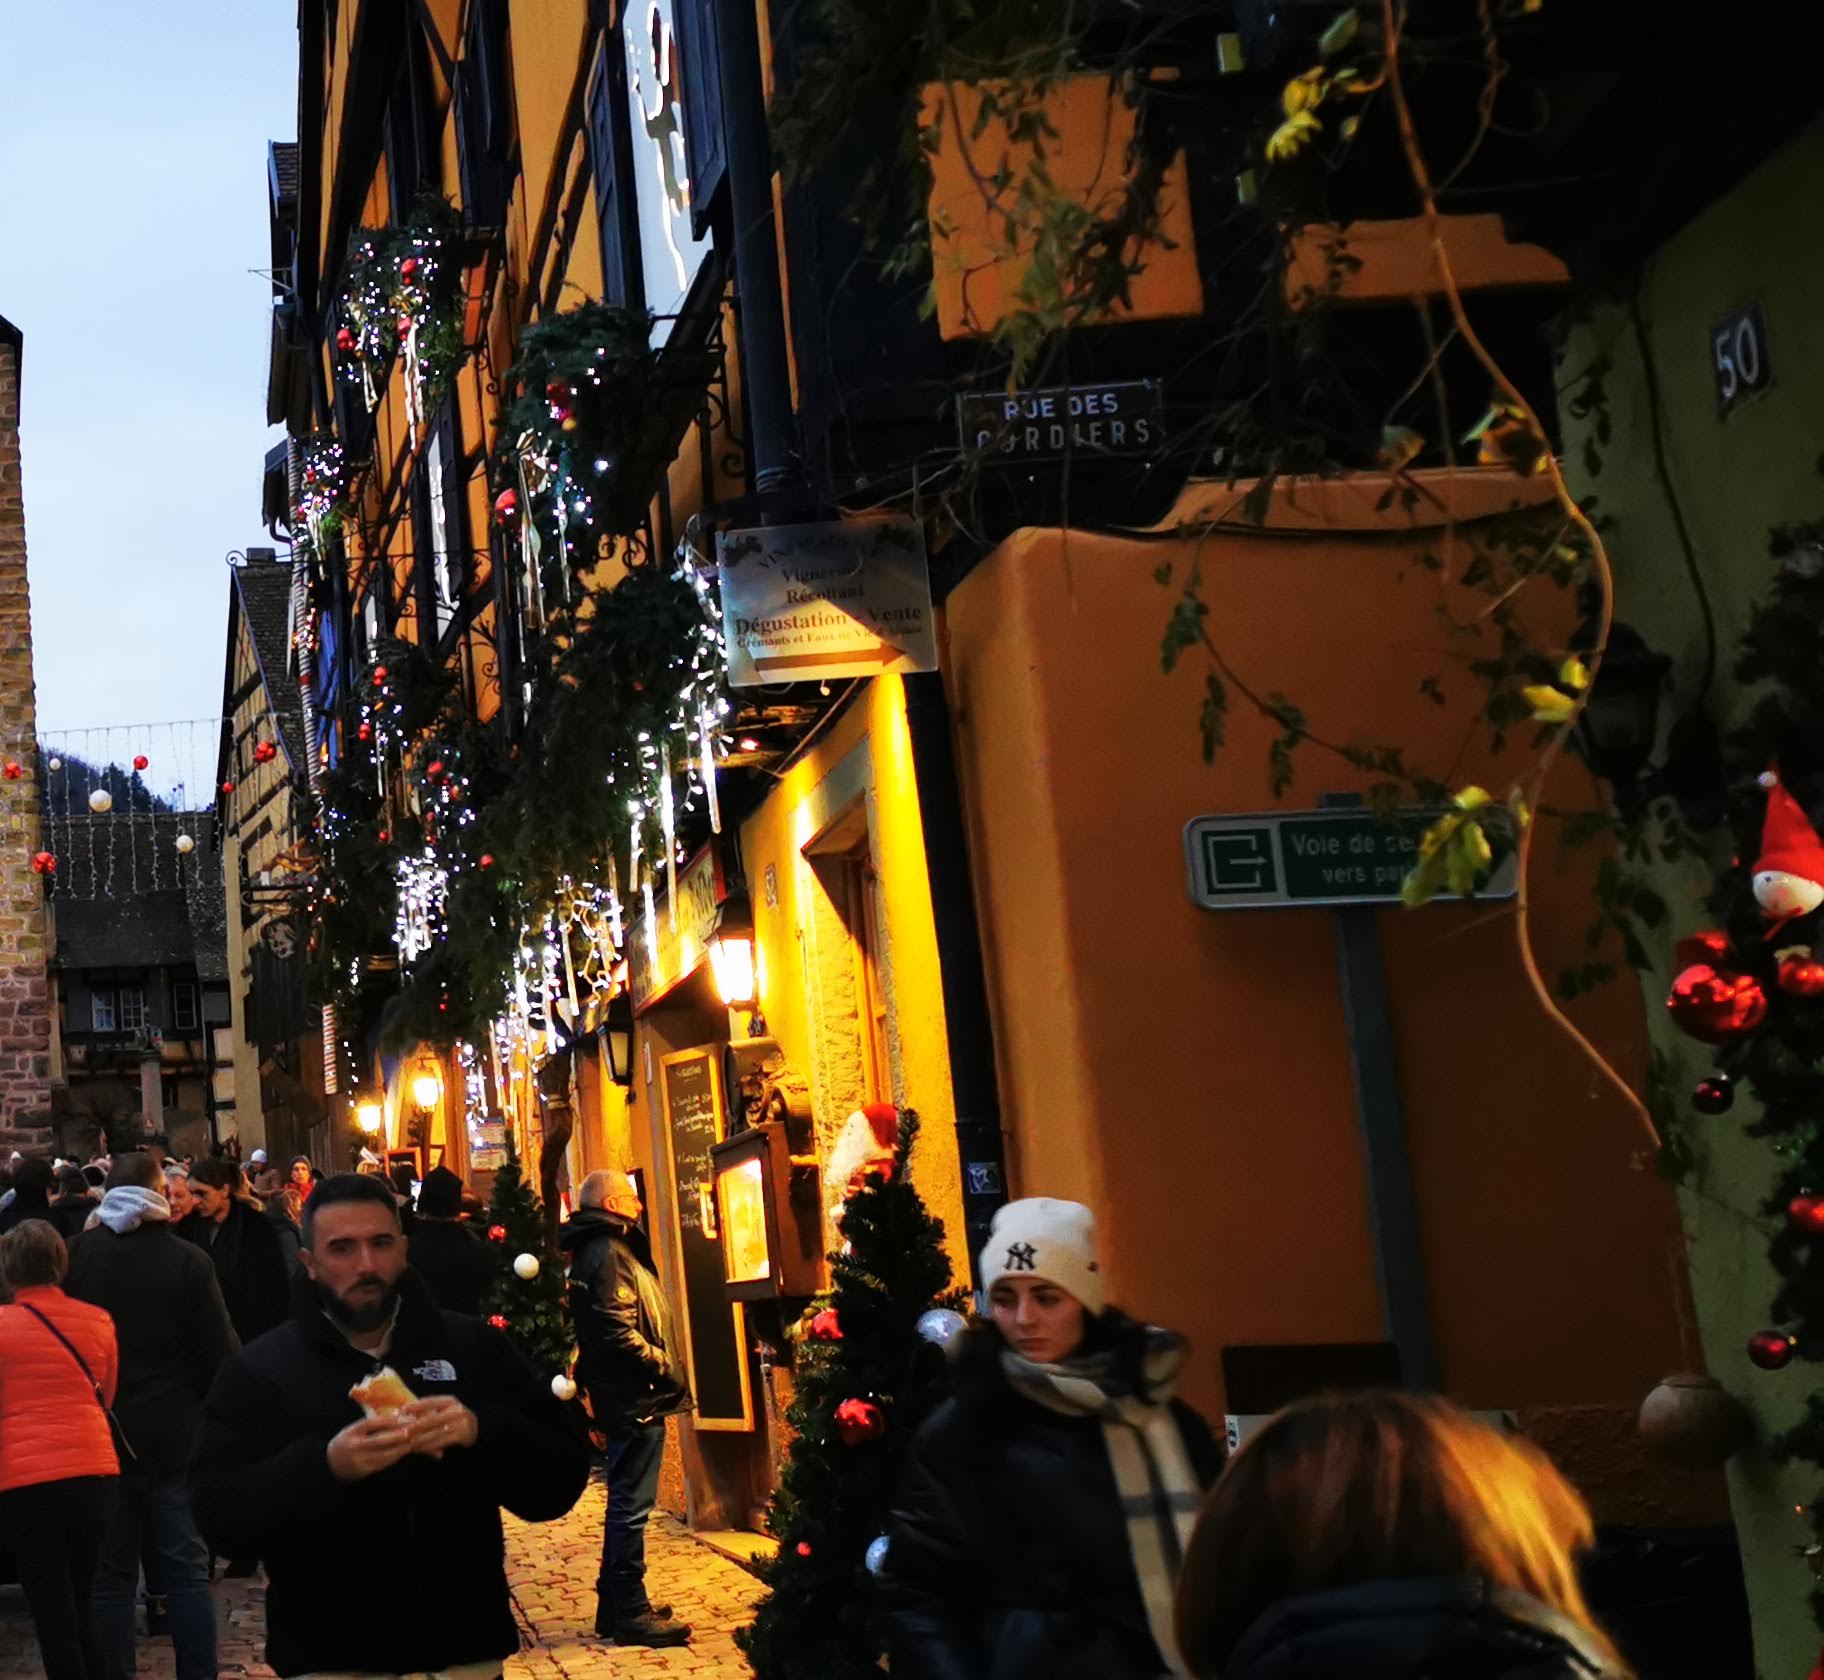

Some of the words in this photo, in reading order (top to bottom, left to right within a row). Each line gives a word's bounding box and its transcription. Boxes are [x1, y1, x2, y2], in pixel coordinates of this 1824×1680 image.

[1716, 316, 1759, 398] 50
[1002, 397, 1057, 420] RUE
[1068, 393, 1119, 416] DES
[786, 583, 864, 604] Récoltant
[735, 610, 847, 637] Dégustation
[868, 606, 922, 624] Vente
[1291, 833, 1340, 857] Voie
[1349, 832, 1376, 854] de
[1321, 865, 1368, 884] vers
[1004, 1242, 1038, 1271] NY
